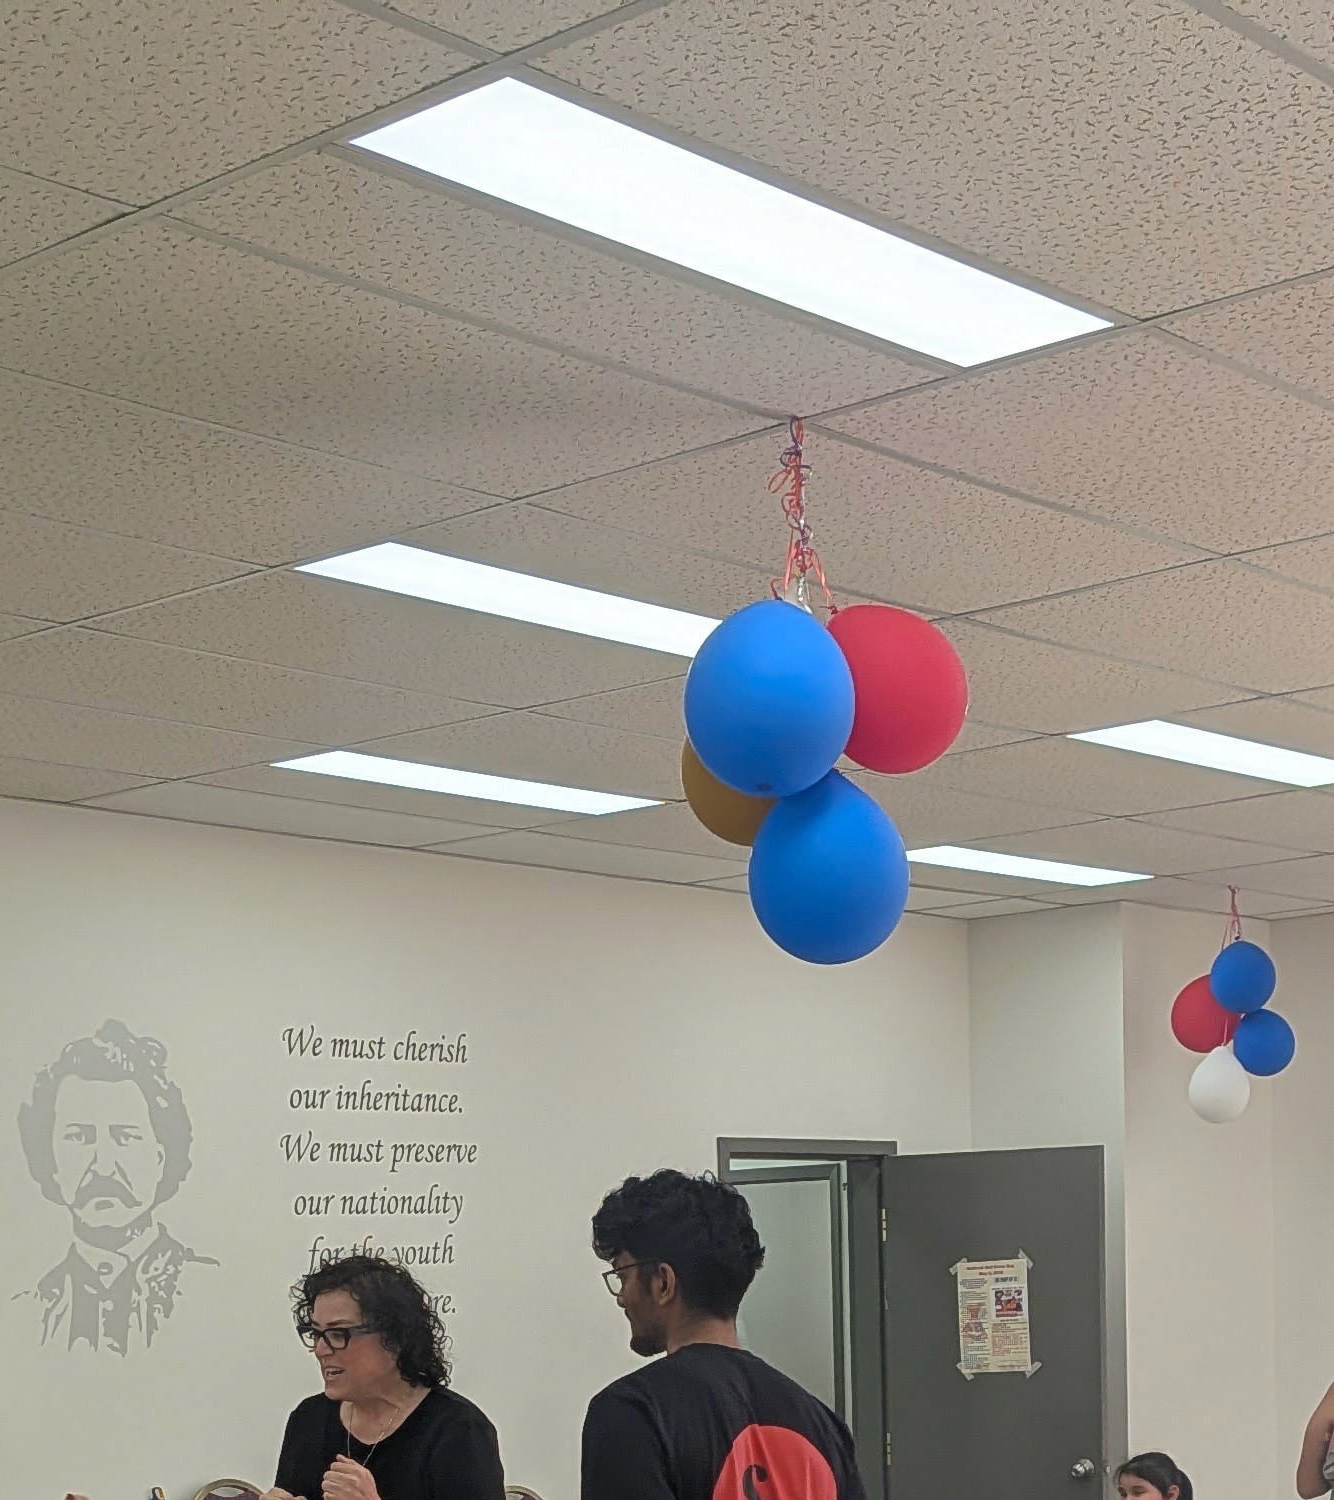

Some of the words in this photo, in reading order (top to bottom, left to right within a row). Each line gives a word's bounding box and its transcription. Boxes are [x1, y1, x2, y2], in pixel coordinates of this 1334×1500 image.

[282, 1024, 323, 1057] We
[330, 1036, 386, 1060] must
[393, 1030, 468, 1064] cherish
[289, 1087, 331, 1110] our
[335, 1080, 463, 1114] inheritance.
[280, 1130, 321, 1163] We
[328, 1139, 384, 1163] must
[389, 1142, 478, 1173] preserve
[294, 1194, 336, 1216] our
[339, 1183, 463, 1224] nationality
[308, 1235, 345, 1274] for
[391, 1233, 455, 1266] youth
